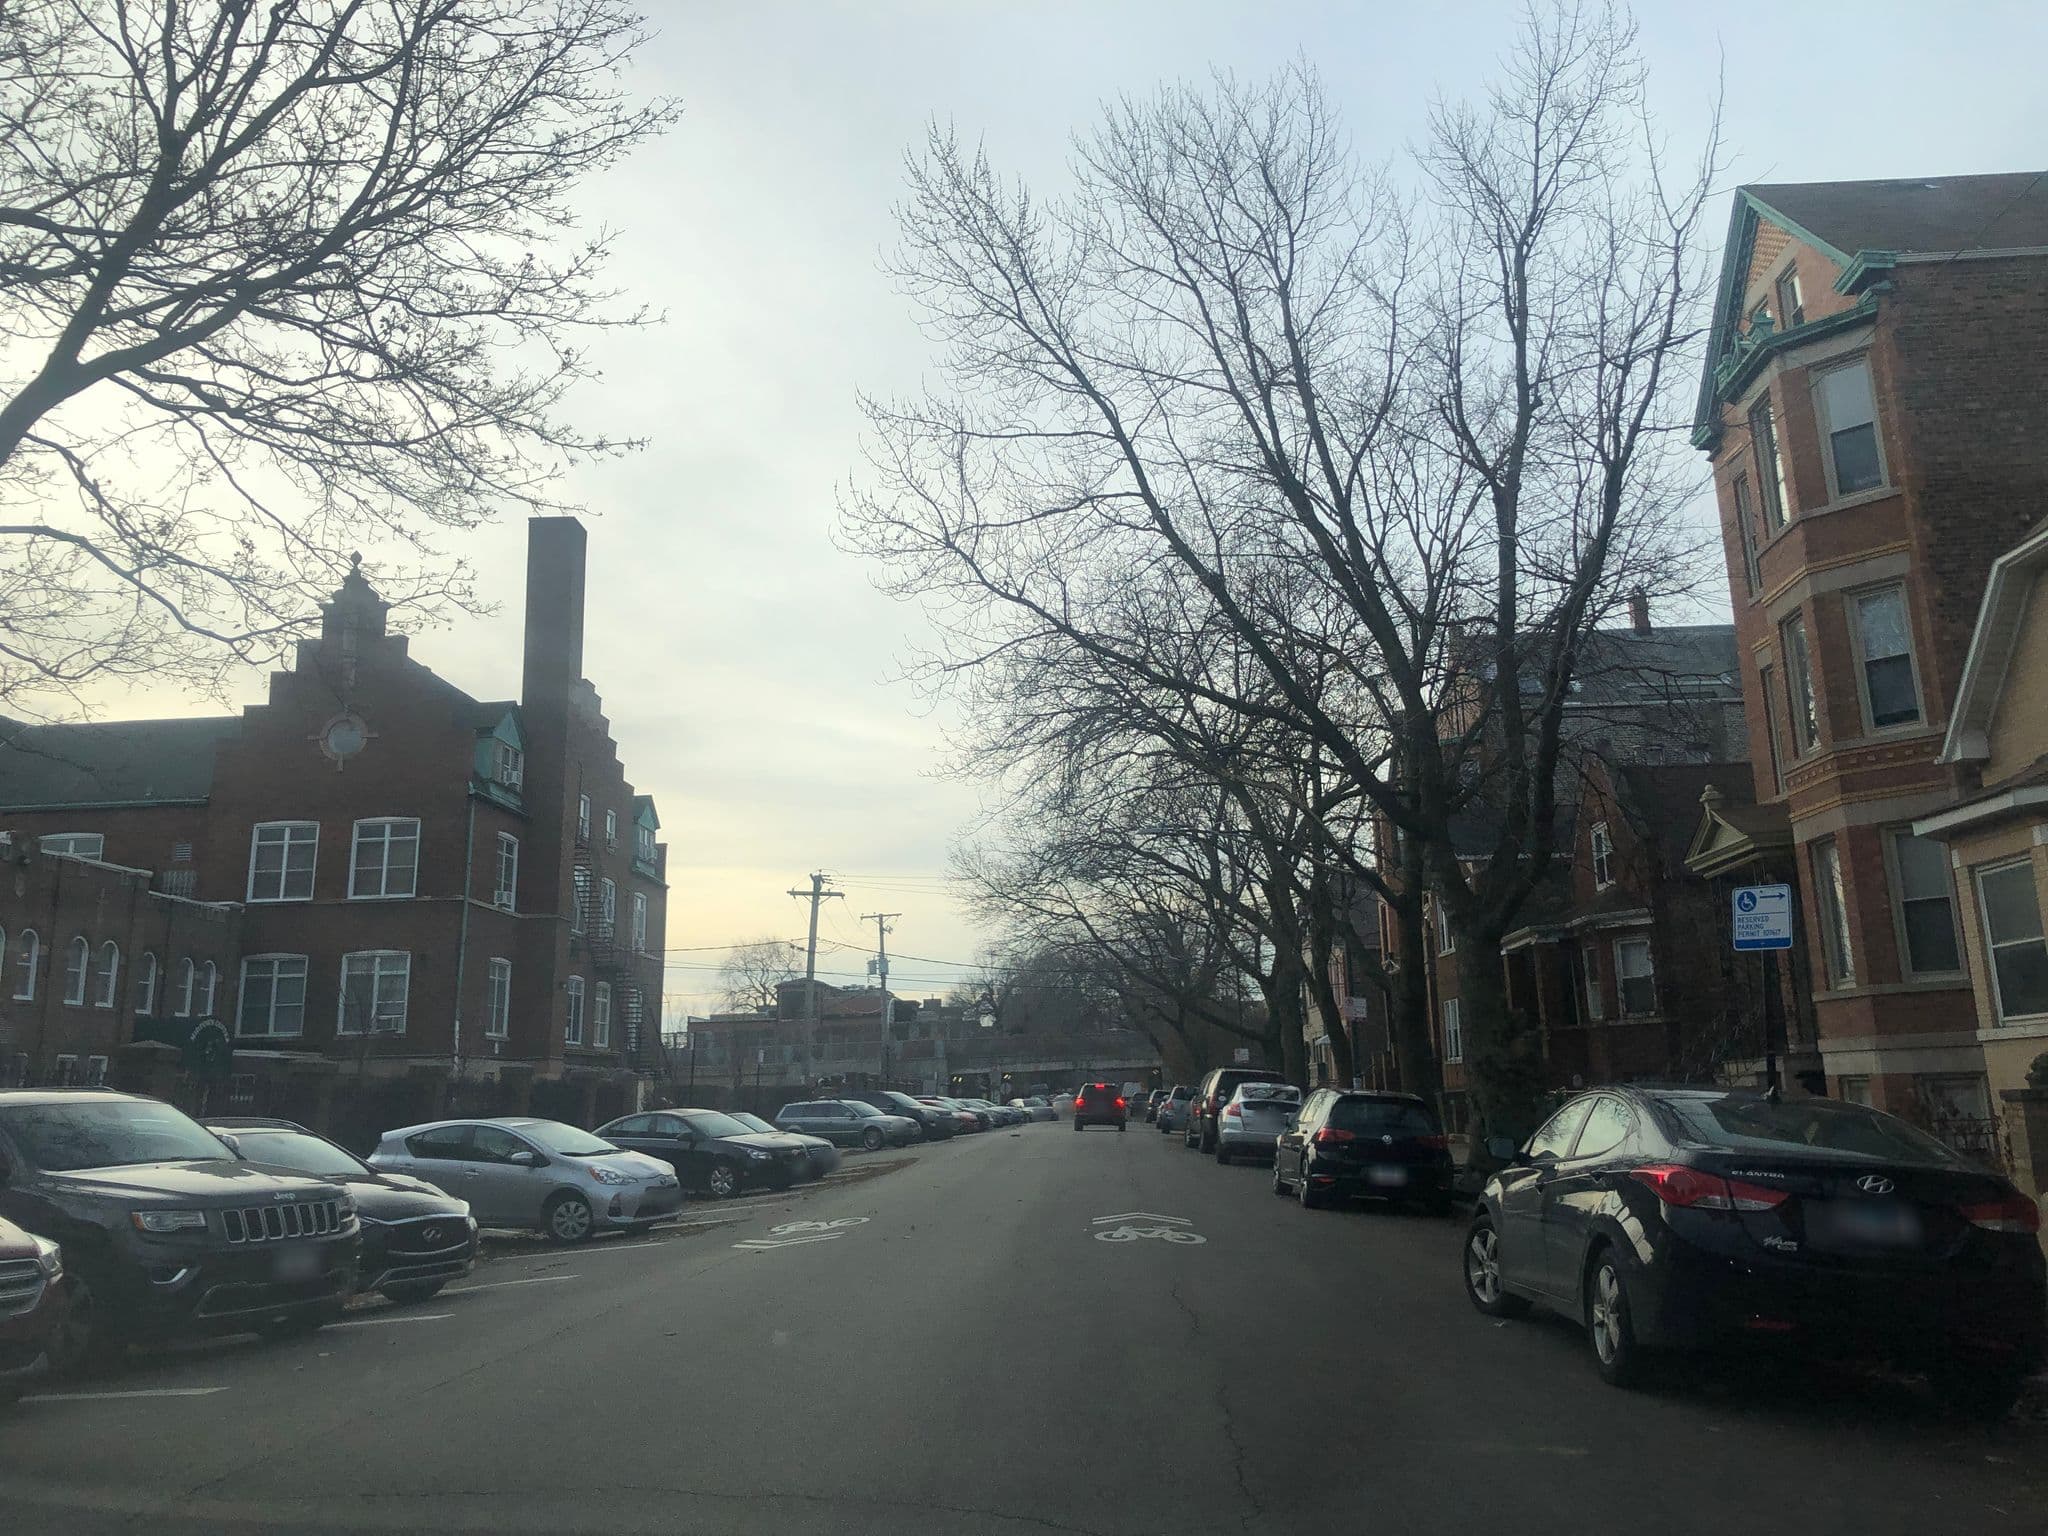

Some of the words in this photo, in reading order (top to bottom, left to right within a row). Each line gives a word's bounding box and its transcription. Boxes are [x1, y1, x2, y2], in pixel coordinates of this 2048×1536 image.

[1737, 915, 1769, 923] RESERVED
[1737, 922, 1764, 931] PARKING
[1738, 929, 1760, 938] PERMIT
[1731, 1170, 1785, 1179] ELANTRA
[273, 1191, 297, 1202] Jeep
